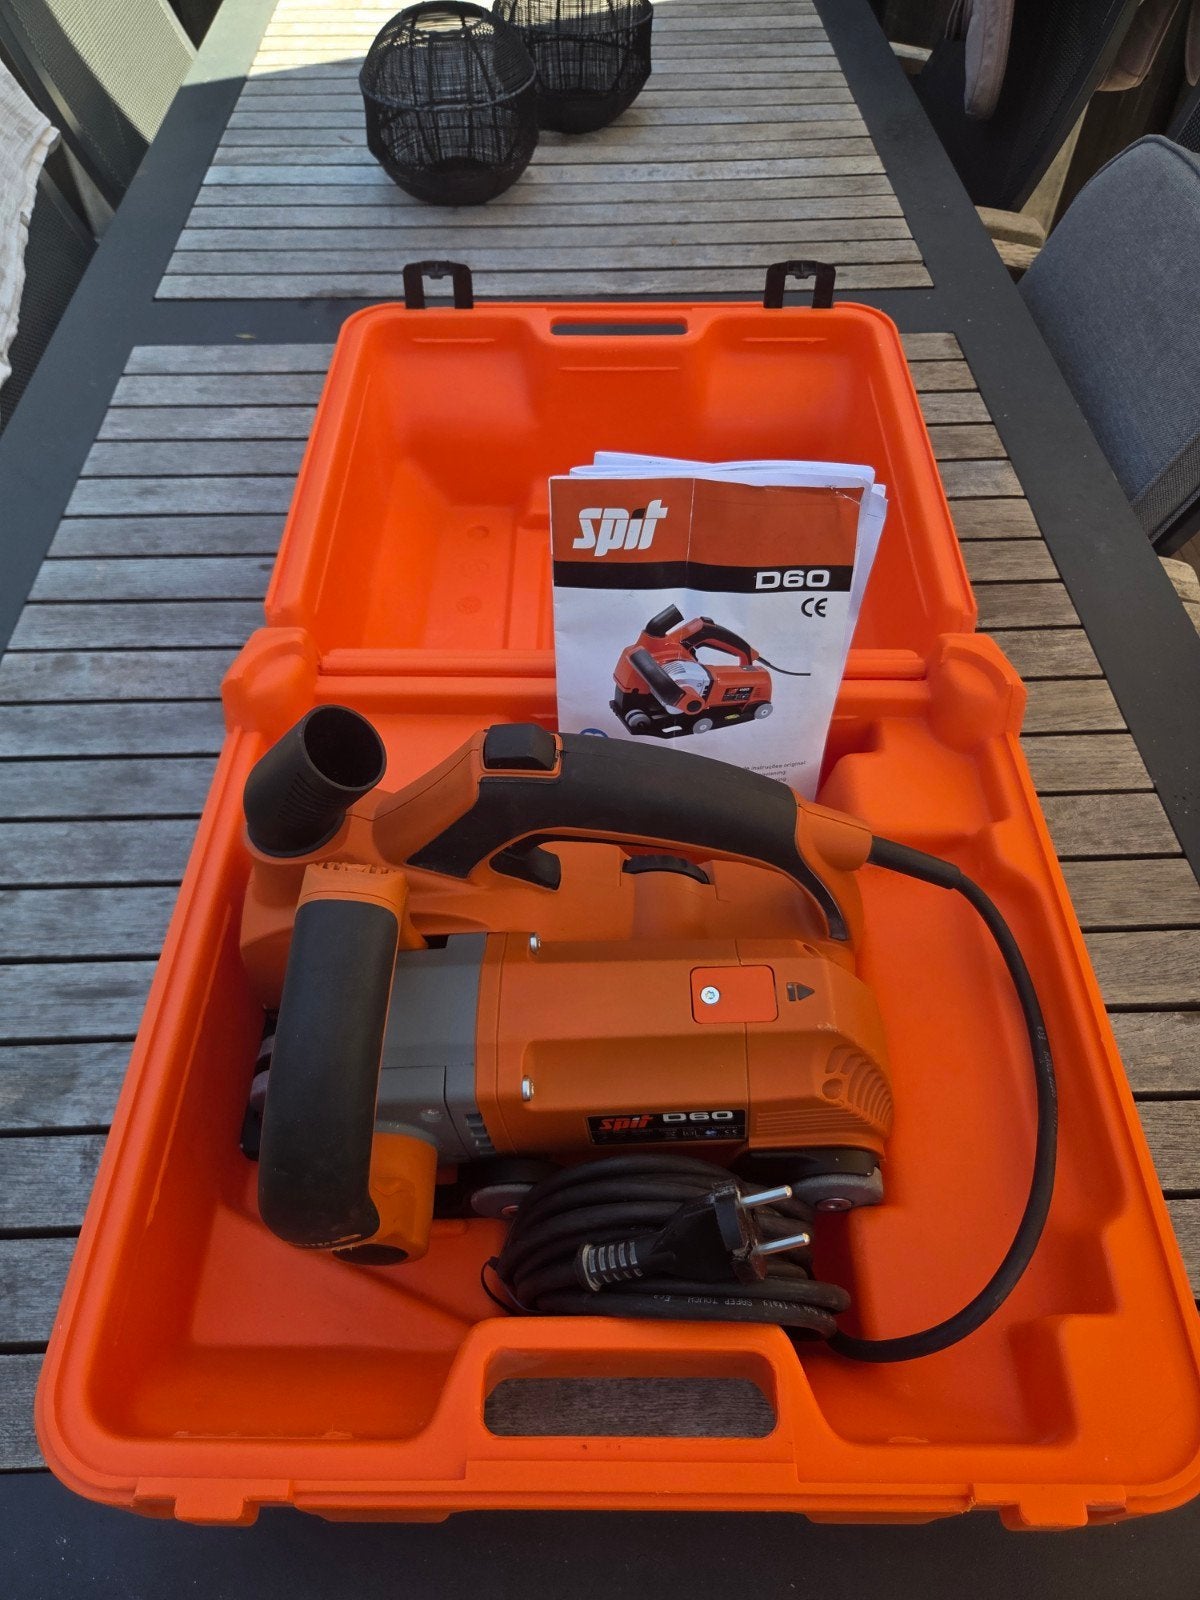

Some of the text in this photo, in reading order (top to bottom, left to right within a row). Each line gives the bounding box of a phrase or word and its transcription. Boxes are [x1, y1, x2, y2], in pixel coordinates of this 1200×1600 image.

[572, 499, 669, 557] spit
[755, 569, 830, 590] D60
[800, 597, 828, 618] CE
[600, 1110, 734, 1131] spit D60
